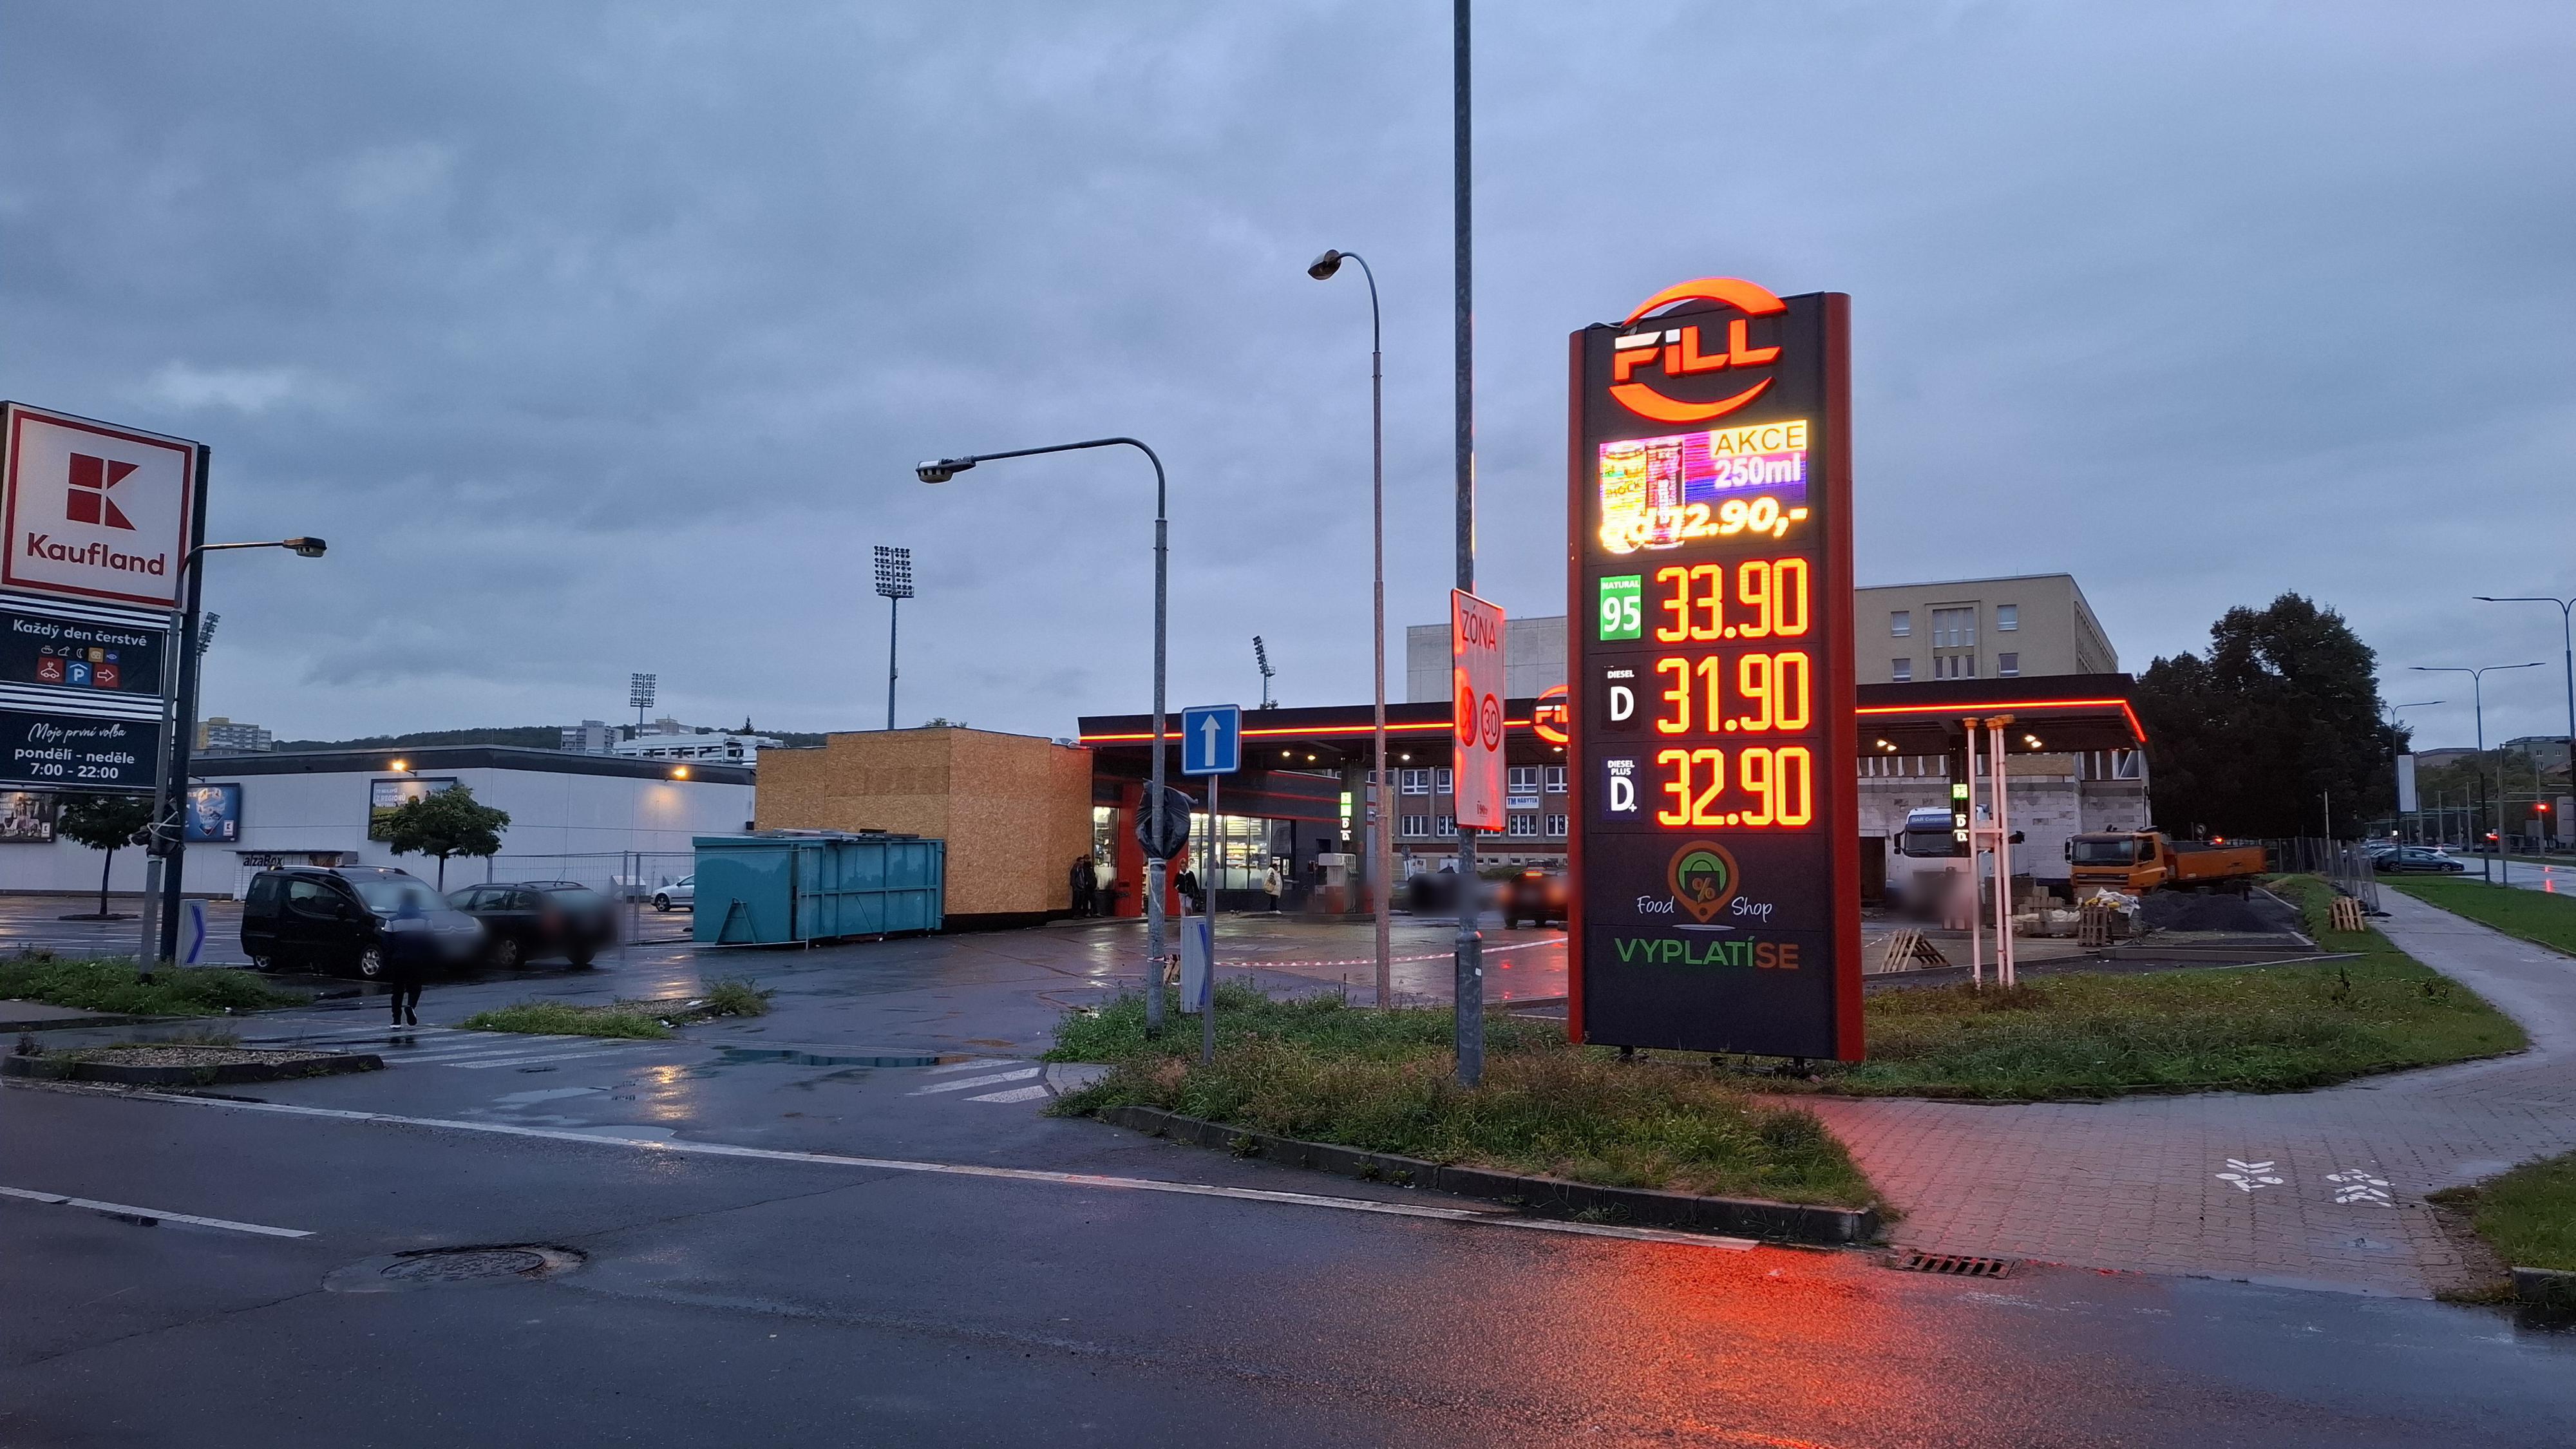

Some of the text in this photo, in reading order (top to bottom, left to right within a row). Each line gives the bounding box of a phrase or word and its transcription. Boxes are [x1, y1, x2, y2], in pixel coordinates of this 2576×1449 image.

[1714, 425, 1804, 456] AKCE
[1714, 453, 1801, 489] 250ml
[26, 532, 166, 576] Kaufland
[1602, 580, 1640, 590] NATURAL
[1602, 558, 1808, 643] 95 33.90
[13, 619, 147, 647] Každý den čerstvé
[1462, 605, 1497, 652] ZÓNA
[1607, 670, 1635, 679] DIESEL
[1610, 652, 1810, 734] D 31.90
[28, 723, 127, 744] Moje první volba
[1484, 708, 1497, 739] 30
[15, 748, 73, 761] pondělí
[86, 752, 135, 764] neděle
[1607, 759, 1636, 769] DIESEL
[30, 762, 63, 776] 7:00
[77, 765, 119, 779] 22:00
[1611, 768, 1632, 776] PLUS
[1656, 746, 1812, 827] 32.90
[243, 854, 283, 867] alzaBox
[1636, 895, 1772, 923] Food Shop
